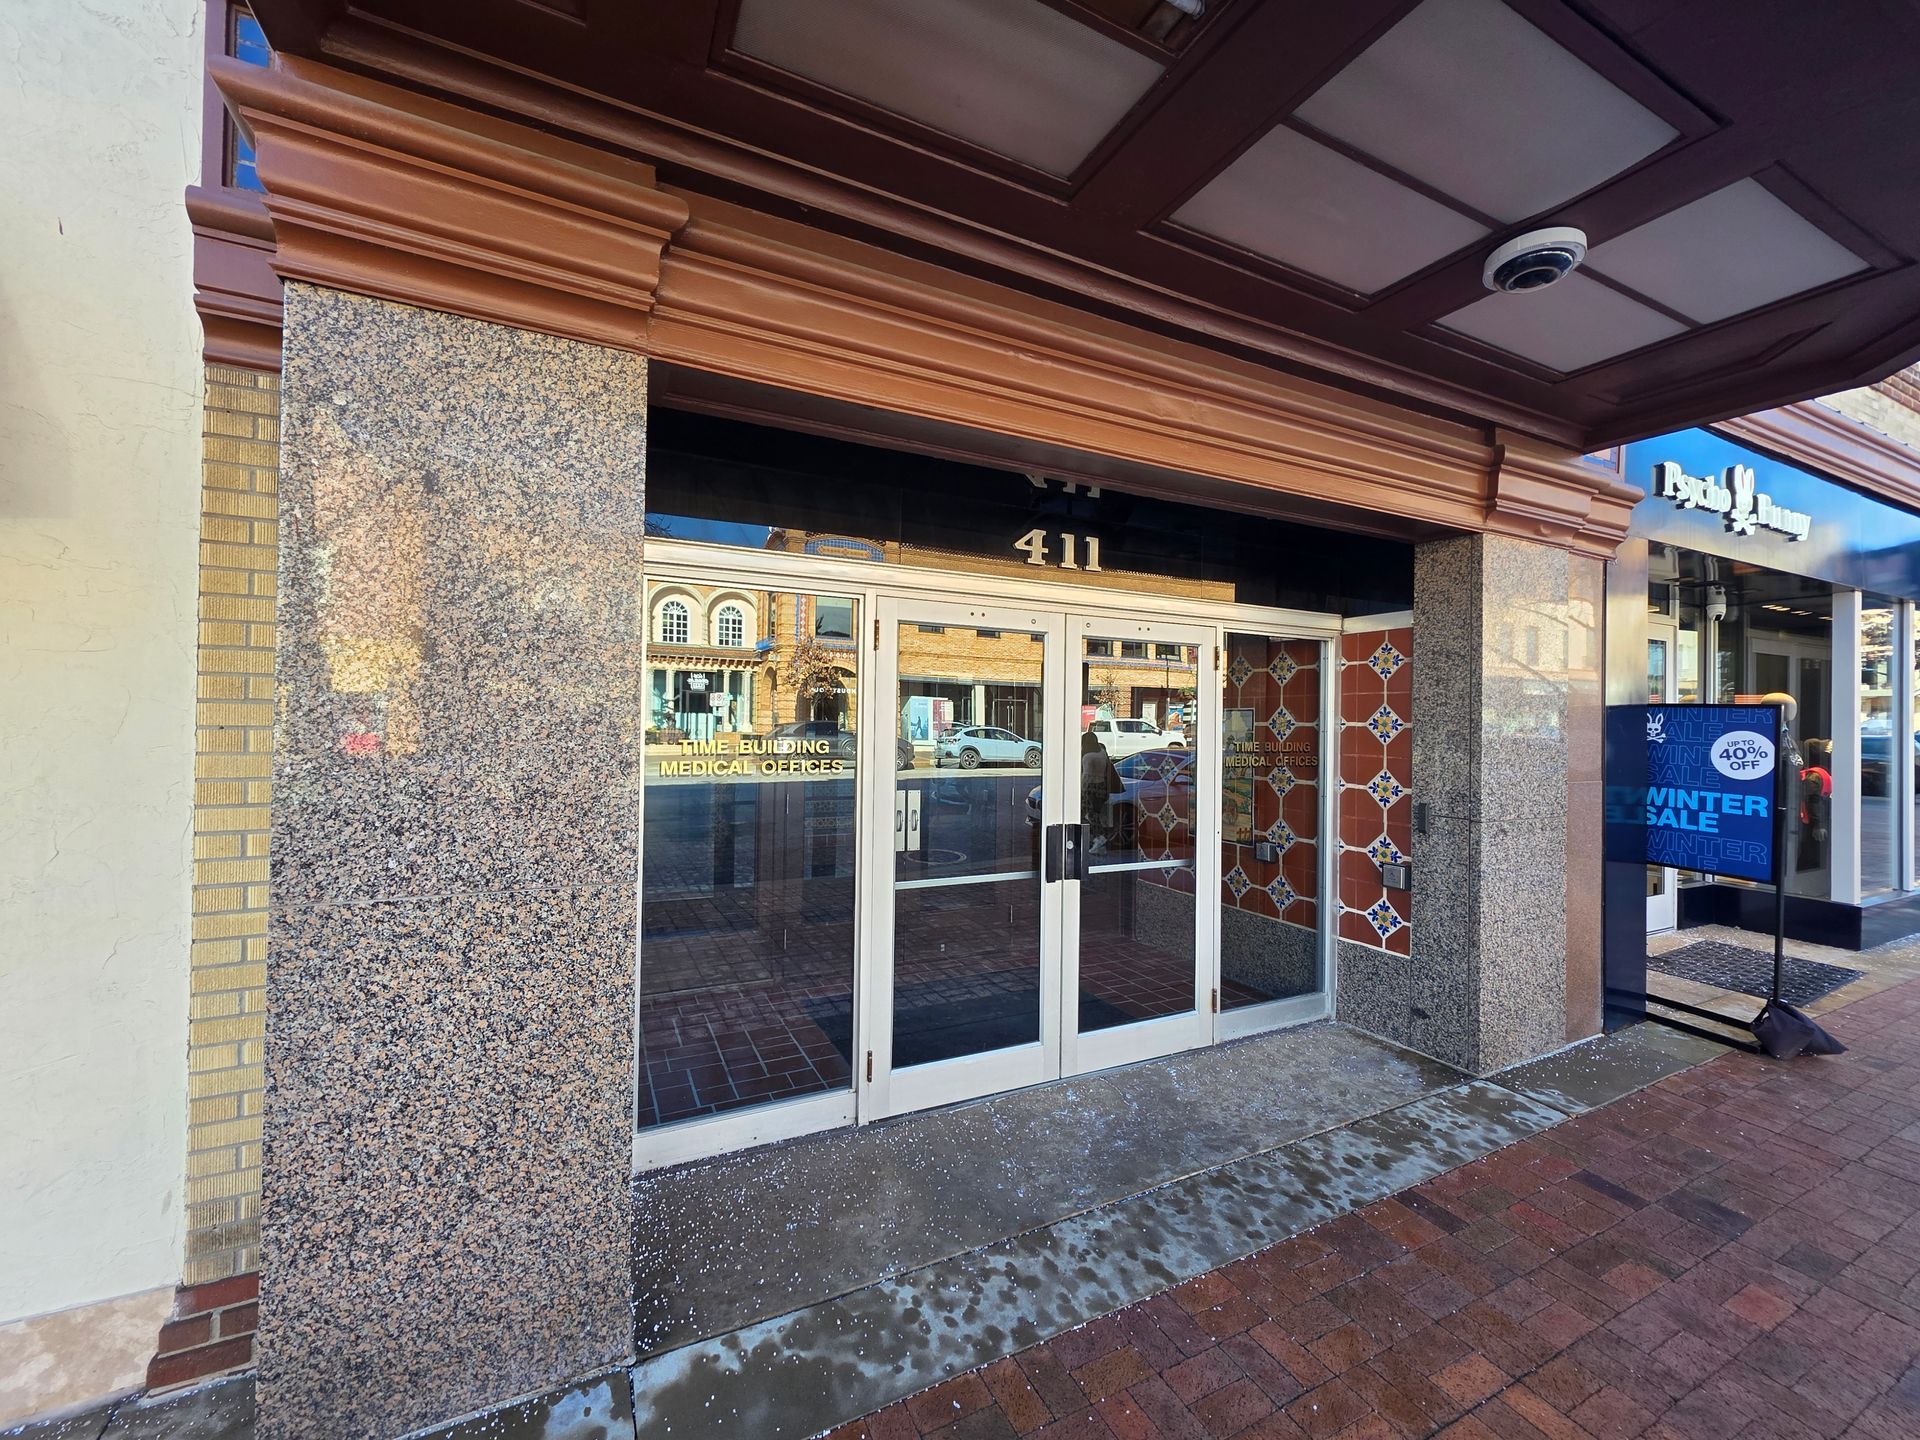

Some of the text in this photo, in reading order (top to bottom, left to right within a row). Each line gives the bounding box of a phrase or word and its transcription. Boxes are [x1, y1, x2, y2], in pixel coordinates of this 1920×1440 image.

[1662, 461, 1812, 541] Psycho Bunny
[1014, 528, 1102, 572] 411
[1664, 721, 1724, 743] ALE
[679, 739, 831, 756] TIME BUILDING
[1235, 741, 1311, 753] TIME BUILDING
[1719, 746, 1769, 761] 40%
[1727, 740, 1740, 748] UP
[1225, 755, 1318, 768] MEDICAL OFFICES
[1648, 744, 1714, 768] WINT
[1729, 760, 1760, 771] OFF
[659, 759, 844, 777] MEDICAL OFFICES
[1647, 786, 1769, 817] WINTER
[1647, 806, 1719, 833] SALE
[1648, 829, 1767, 865] WINTER
